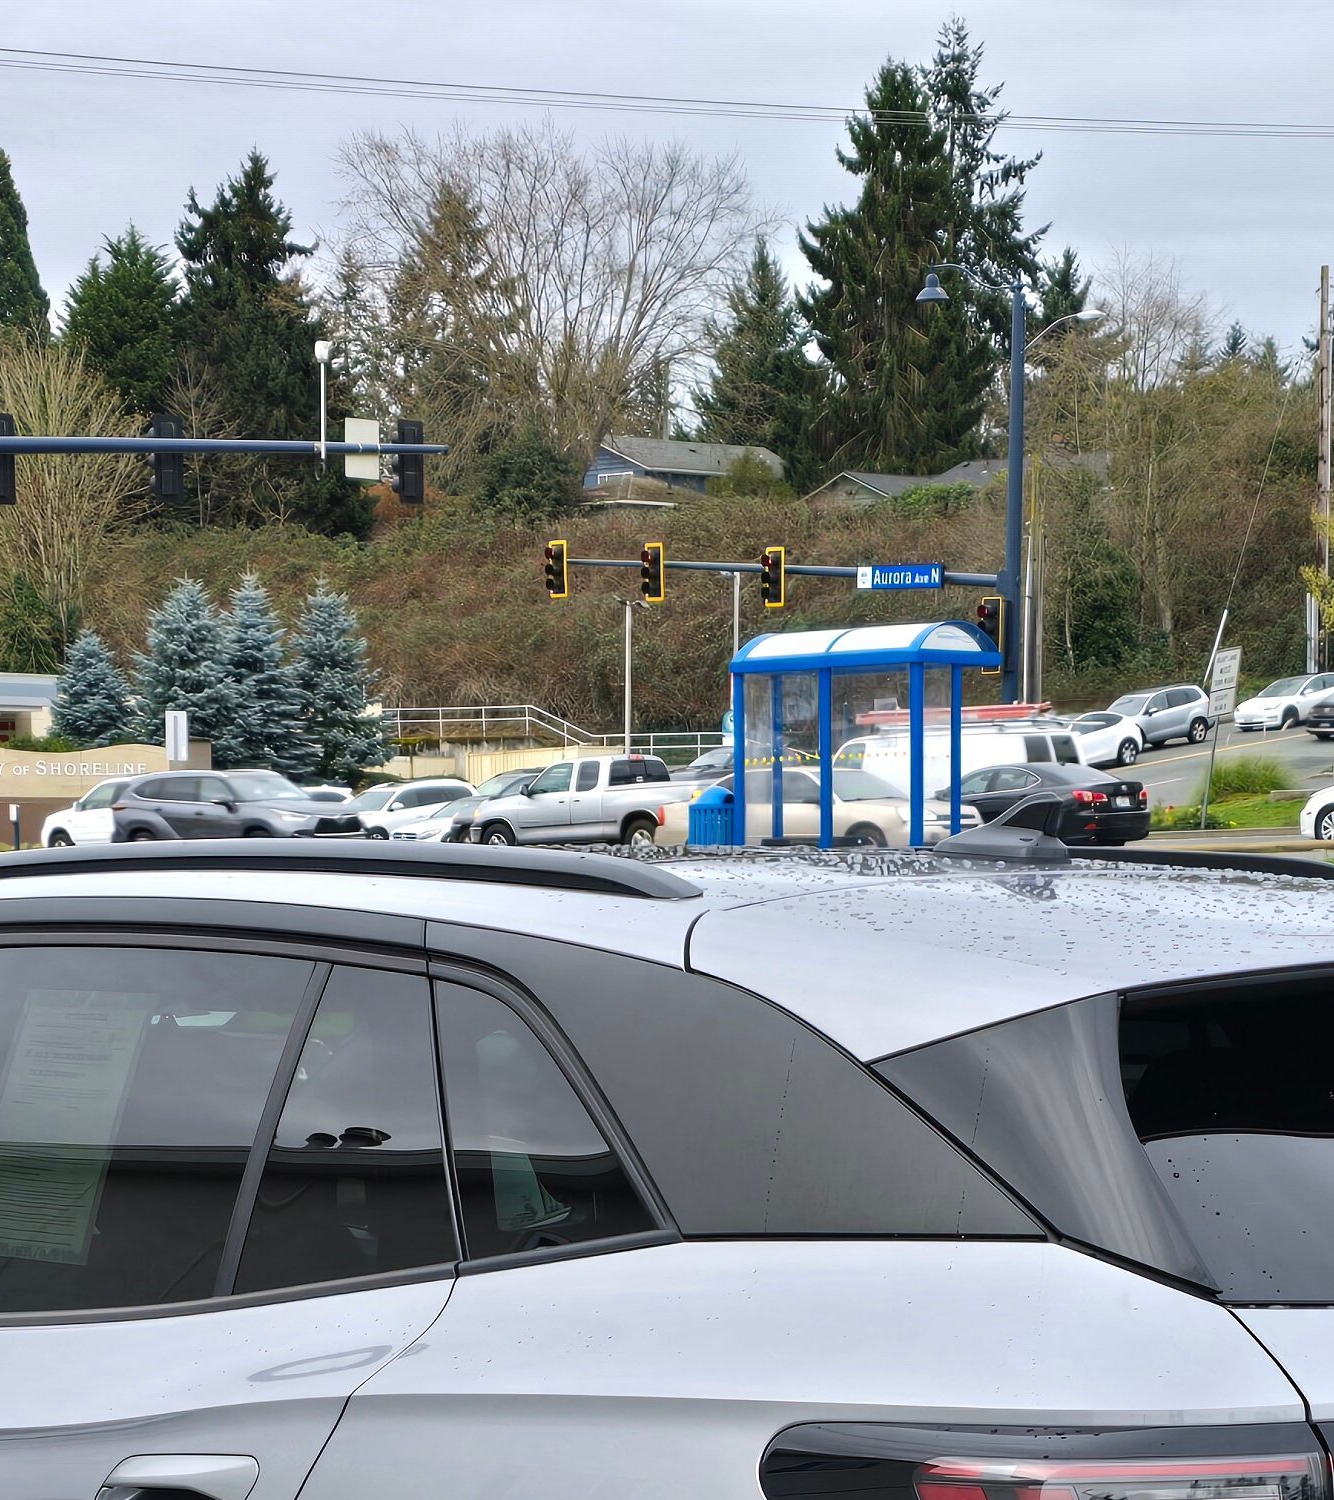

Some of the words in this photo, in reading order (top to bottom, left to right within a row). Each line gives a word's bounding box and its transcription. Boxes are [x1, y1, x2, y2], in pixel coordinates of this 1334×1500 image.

[873, 569, 912, 585] Aurora
[914, 573, 929, 584] Ave
[931, 567, 939, 584] N
[12, 765, 30, 776] OF
[35, 760, 147, 776] SHORELINE
